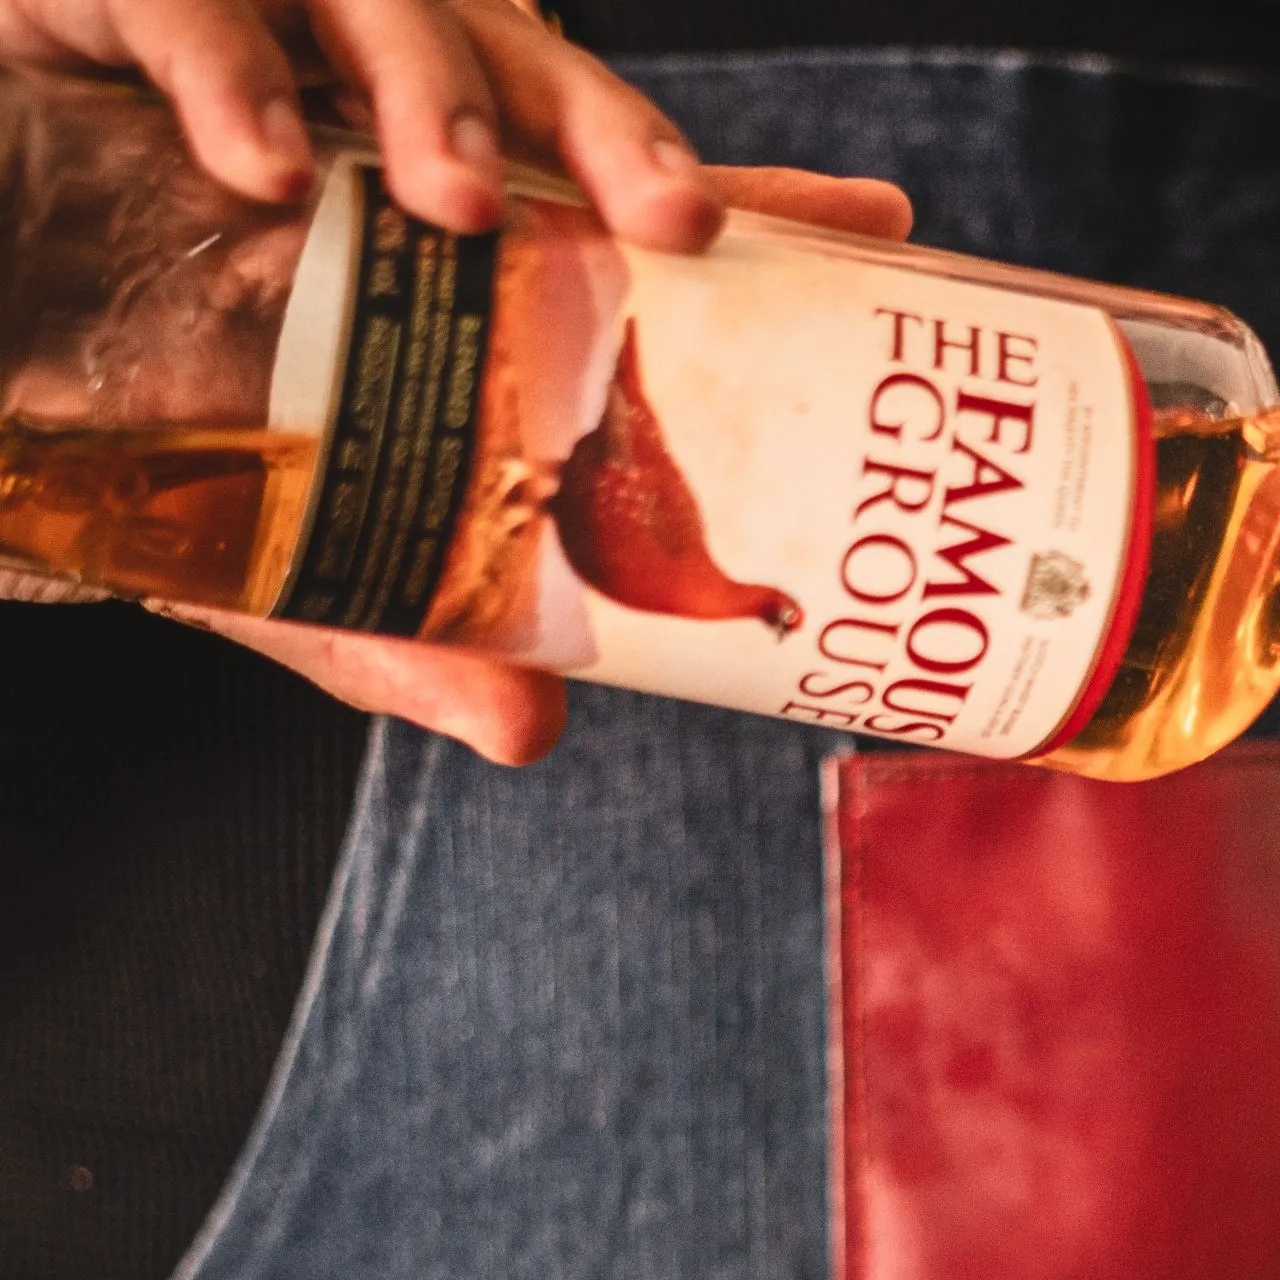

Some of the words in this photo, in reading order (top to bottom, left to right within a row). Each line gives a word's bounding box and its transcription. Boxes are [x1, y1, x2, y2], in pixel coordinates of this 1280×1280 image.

[873, 307, 1039, 389] THE
[779, 372, 947, 726] GROUSE
[864, 386, 1036, 741] FAMOUS
